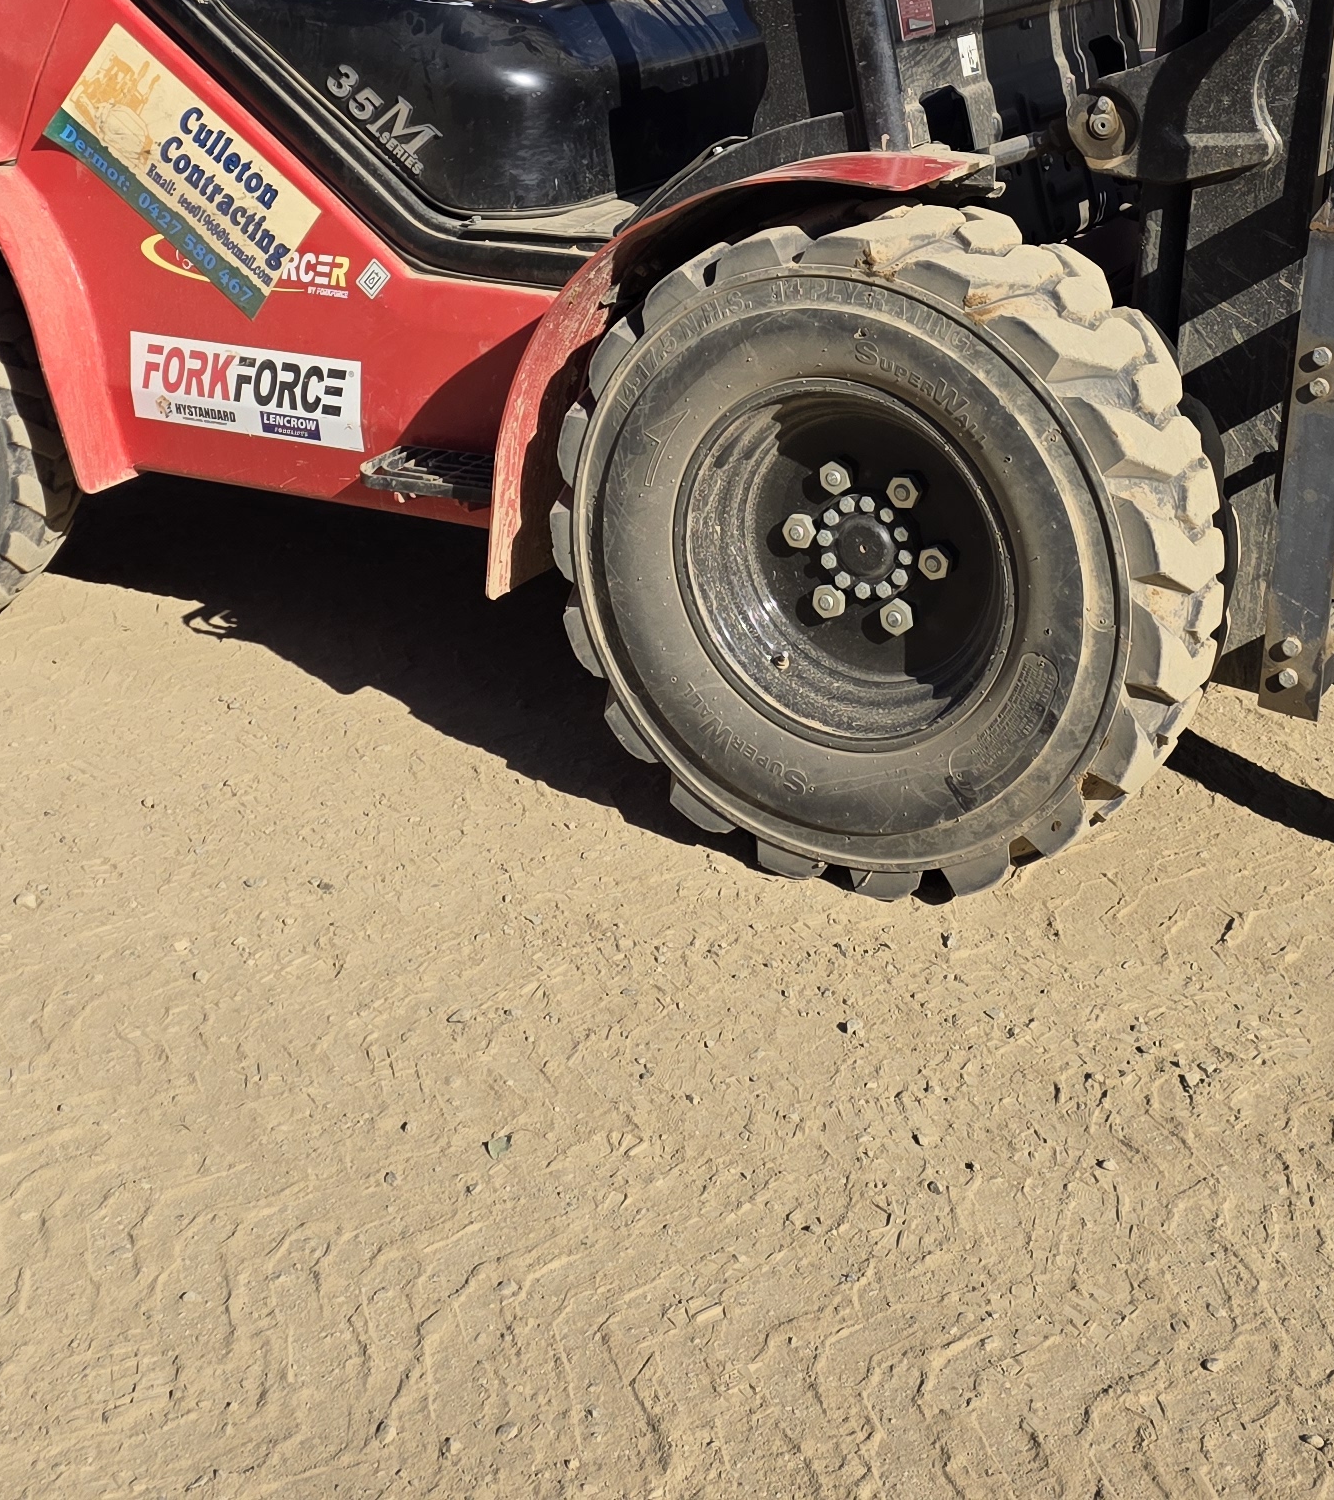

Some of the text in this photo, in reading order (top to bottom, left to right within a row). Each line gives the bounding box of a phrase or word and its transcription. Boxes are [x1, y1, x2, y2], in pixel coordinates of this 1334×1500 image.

[180, 106, 279, 210] Culleton
[378, 130, 425, 177] SERIES
[60, 123, 254, 302] Dermot: 0427 580 467
[160, 136, 291, 271] Contracting
[142, 343, 347, 418] FORKFORCE
[174, 402, 237, 423] HYSTANDARD
[263, 413, 317, 431] LENCROW
